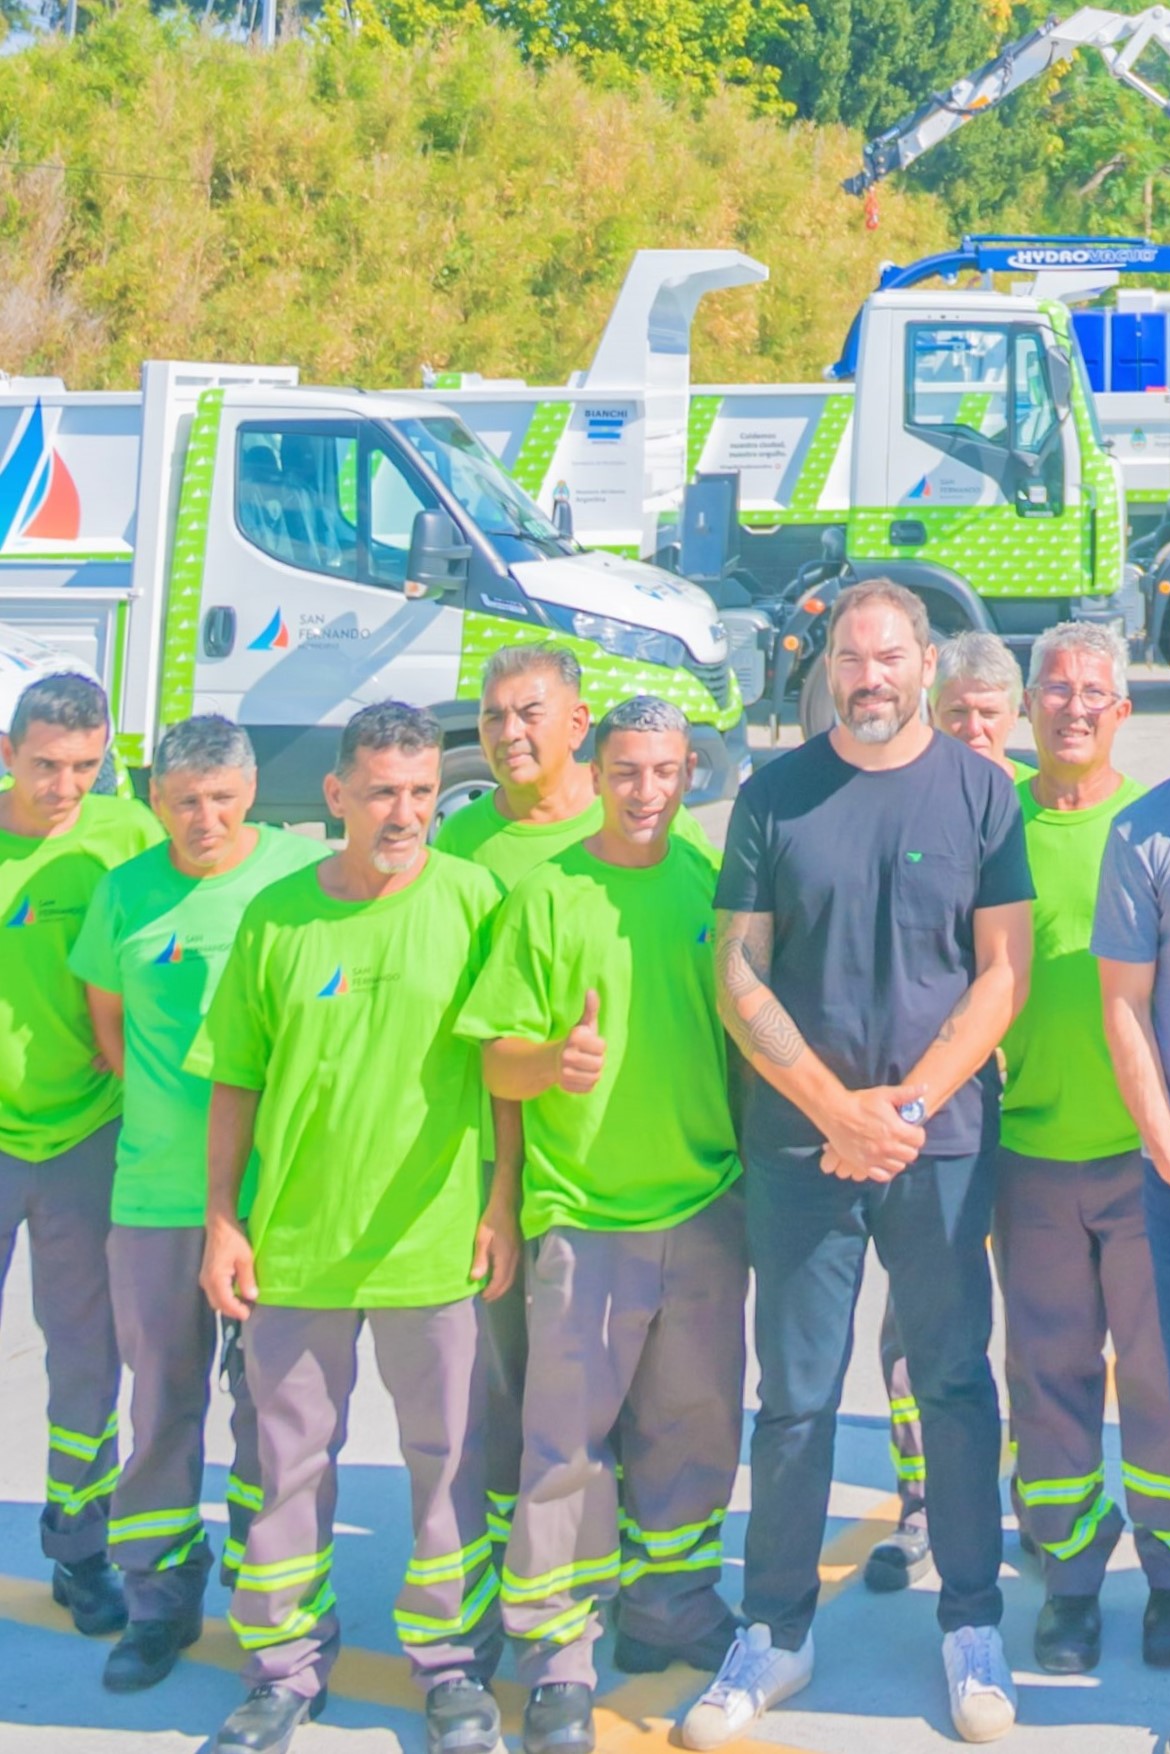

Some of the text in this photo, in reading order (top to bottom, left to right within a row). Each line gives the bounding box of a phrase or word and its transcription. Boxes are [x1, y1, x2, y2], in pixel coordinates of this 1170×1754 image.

[584, 409, 628, 418] BIANCHI
[299, 614, 325, 625] SAN
[299, 628, 371, 641] FERNANDO
